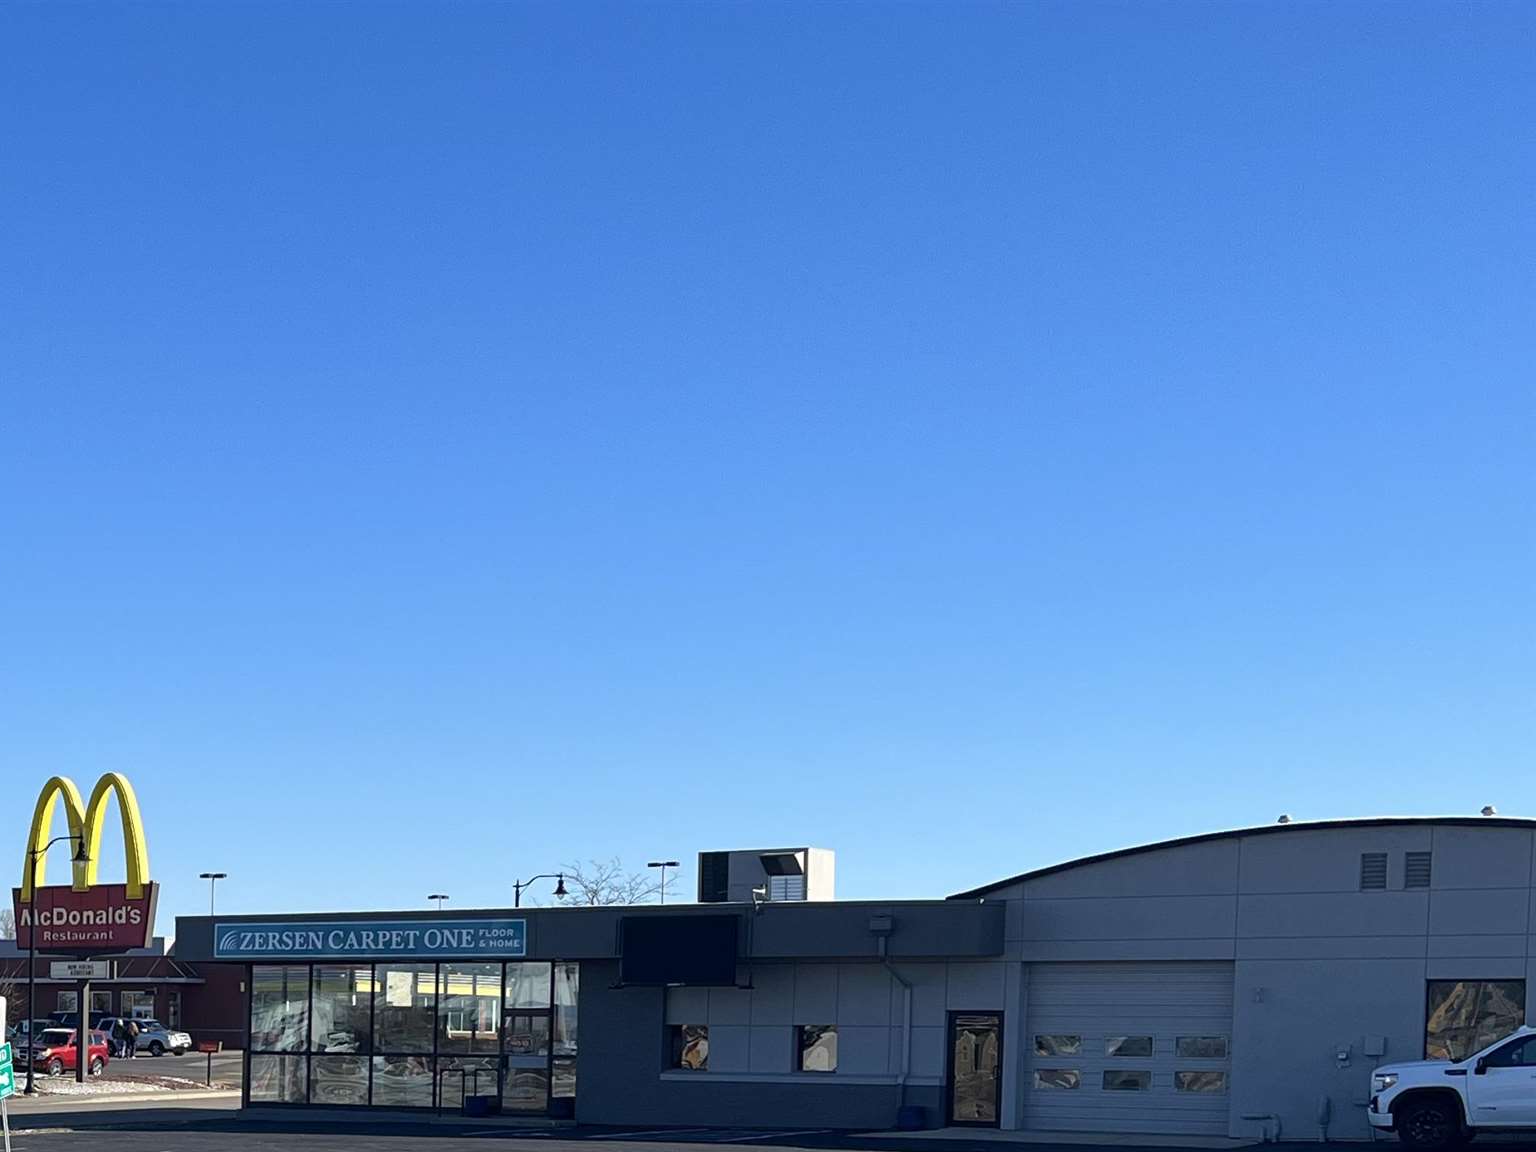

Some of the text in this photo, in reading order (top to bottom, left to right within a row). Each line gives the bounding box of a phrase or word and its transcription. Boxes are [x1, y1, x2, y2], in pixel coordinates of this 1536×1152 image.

[20, 906, 141, 926] McDonald's
[44, 931, 113, 941] Restaurant
[479, 928, 514, 937] FLOOR
[239, 928, 475, 950] ZERSEN CARPET ONE
[489, 939, 520, 948] HOME
